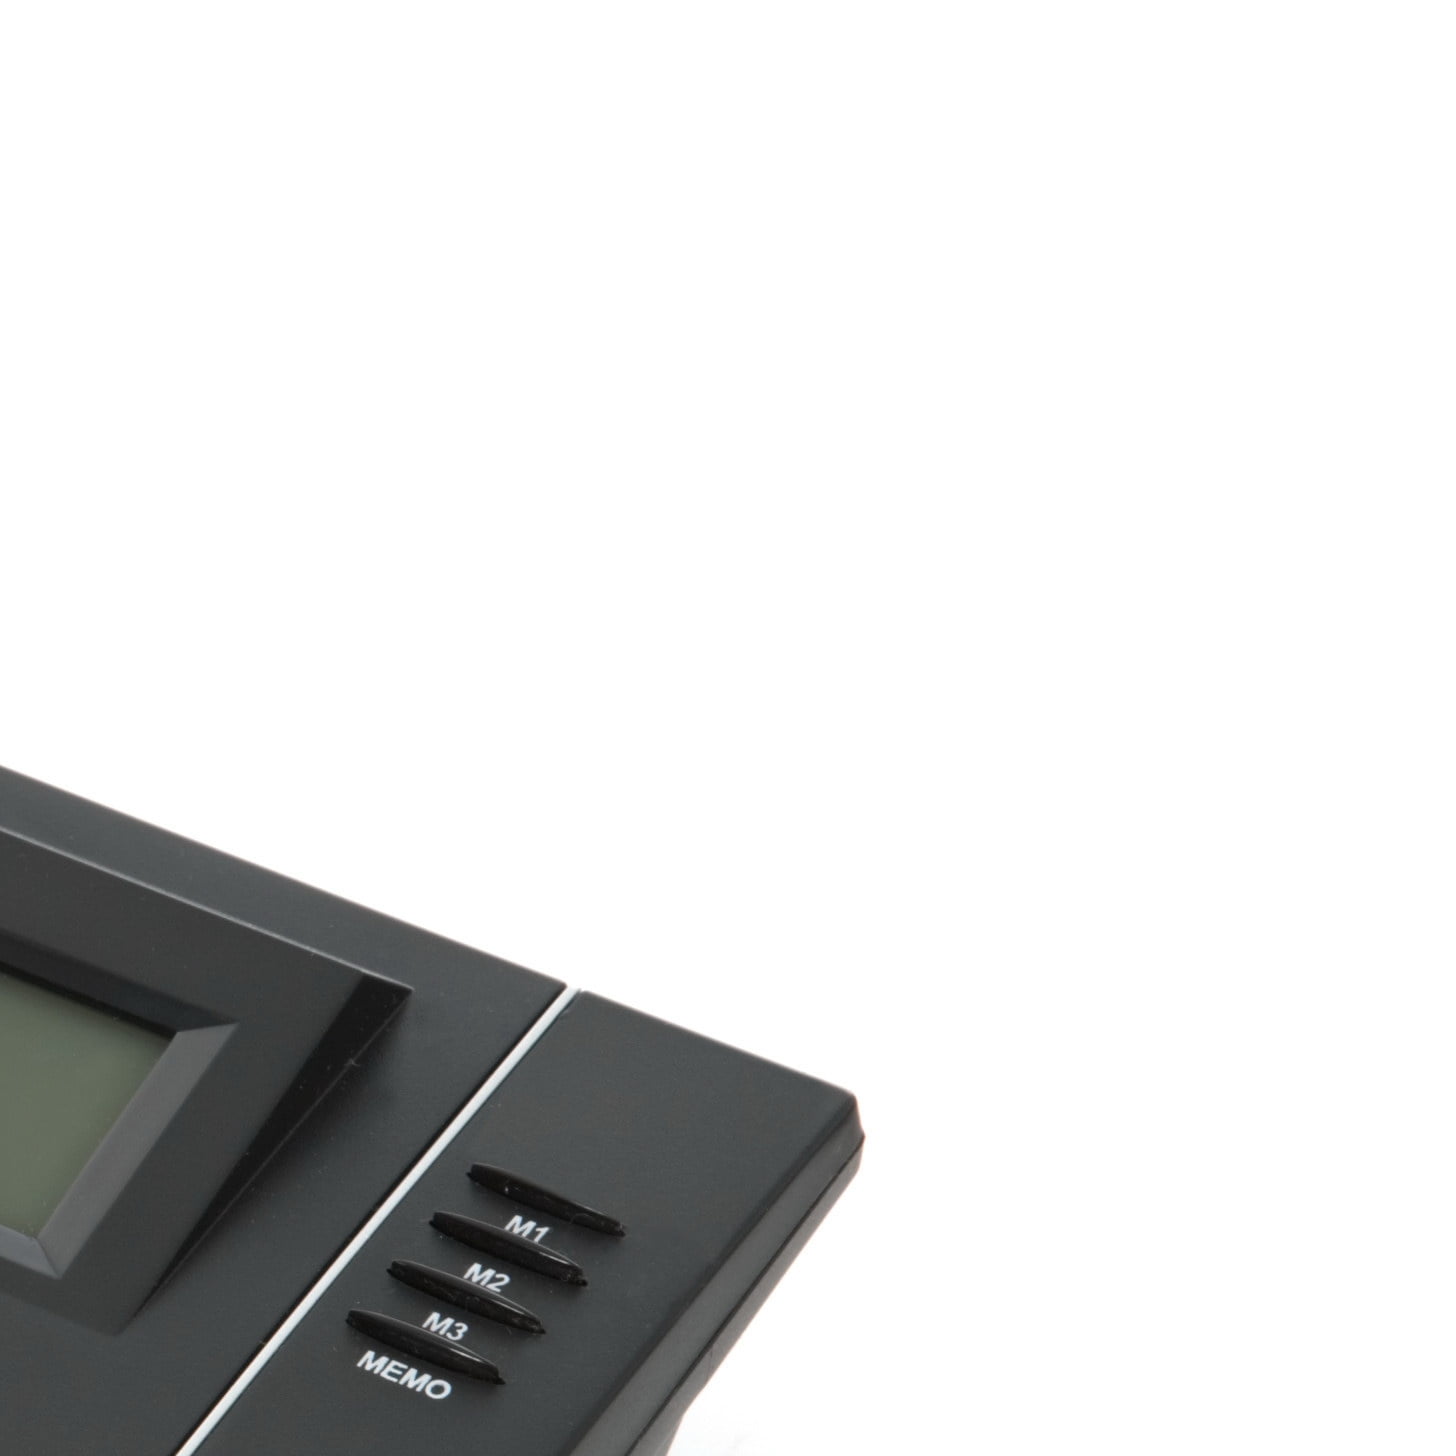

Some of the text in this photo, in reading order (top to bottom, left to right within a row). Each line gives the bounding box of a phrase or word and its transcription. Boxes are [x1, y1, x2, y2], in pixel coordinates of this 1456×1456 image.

[501, 1213, 552, 1246] M1
[460, 1261, 514, 1295] M2
[420, 1310, 471, 1343] M3
[355, 1349, 453, 1401] MEMO
